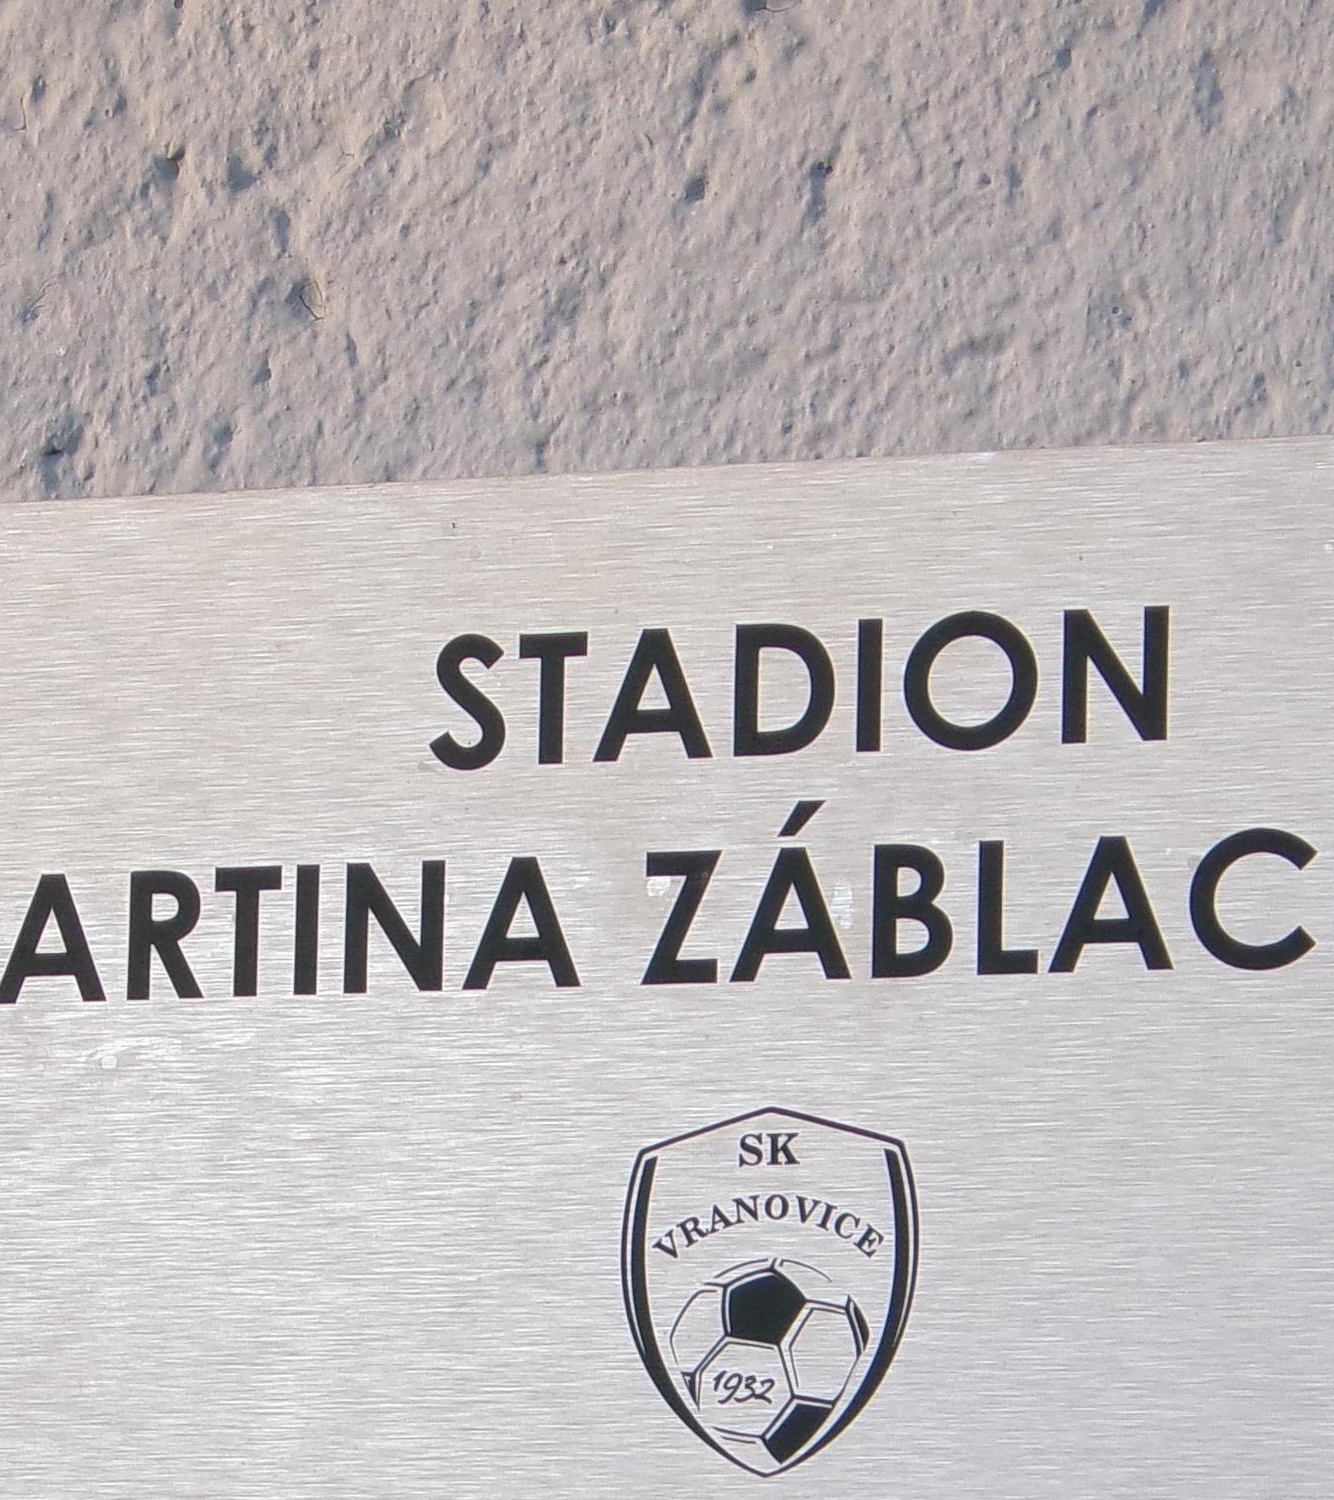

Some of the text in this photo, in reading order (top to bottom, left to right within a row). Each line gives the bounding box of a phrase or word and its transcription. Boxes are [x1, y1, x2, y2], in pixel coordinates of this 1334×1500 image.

[429, 604, 1170, 772] STADION
[738, 1132, 800, 1168] SK
[651, 1193, 885, 1259] VRANOVICE
[712, 1369, 776, 1405] 1932
